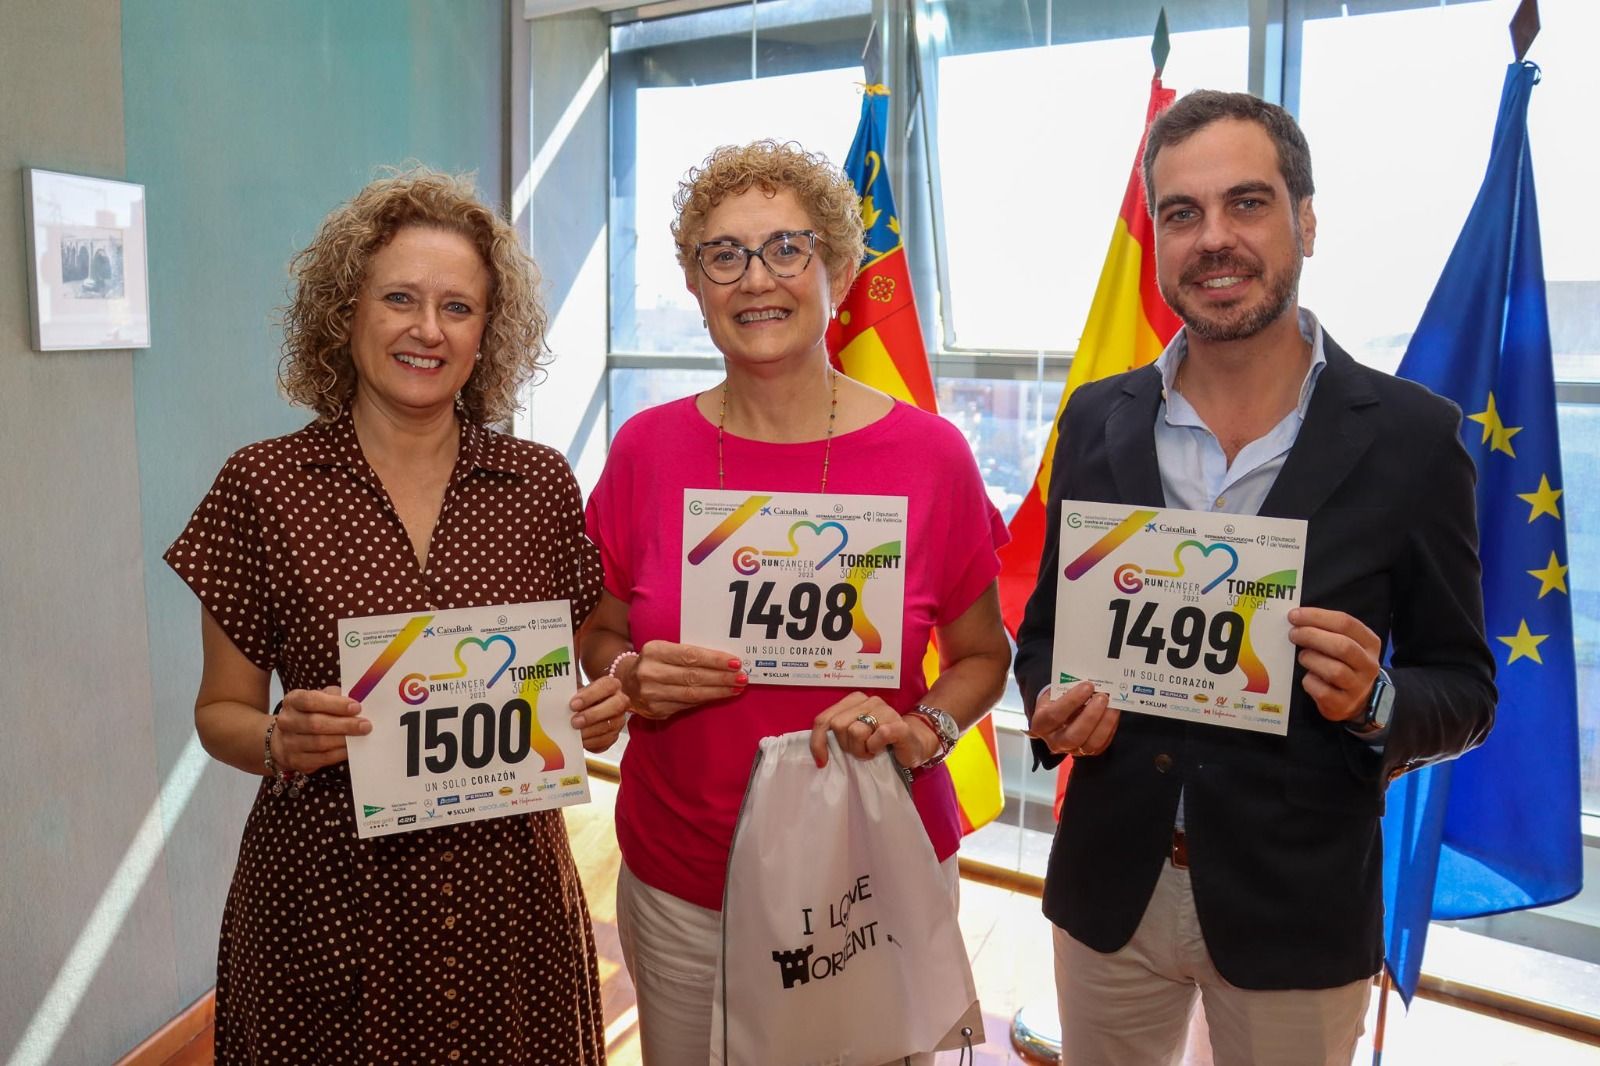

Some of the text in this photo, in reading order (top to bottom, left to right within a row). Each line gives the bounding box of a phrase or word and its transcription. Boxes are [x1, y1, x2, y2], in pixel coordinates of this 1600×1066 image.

[774, 506, 808, 515] CaixaBank
[1160, 524, 1197, 534] CaixaBank
[838, 554, 901, 568] TORRENT
[840, 568, 851, 579] 30
[861, 568, 878, 580] Set.
[1226, 579, 1296, 600] TORRENT
[1226, 594, 1240, 607] 30
[1250, 597, 1270, 610] Set.
[729, 580, 858, 641] 1498
[436, 624, 472, 634] CaixaBank
[1107, 598, 1244, 674] 1499
[745, 646, 833, 656] UN SOLO CORAZÓN
[508, 662, 570, 681] TORRENT
[1124, 668, 1215, 690] UN SOLO CORAZÓN
[512, 682, 523, 694] 30
[534, 680, 552, 691] Set.
[1145, 700, 1167, 708] SKLUM
[400, 698, 532, 777] 1500
[425, 770, 516, 792] UN SOLO CORAZÓN
[453, 808, 476, 816] SKLUM
[802, 874, 872, 935] I LOVE
